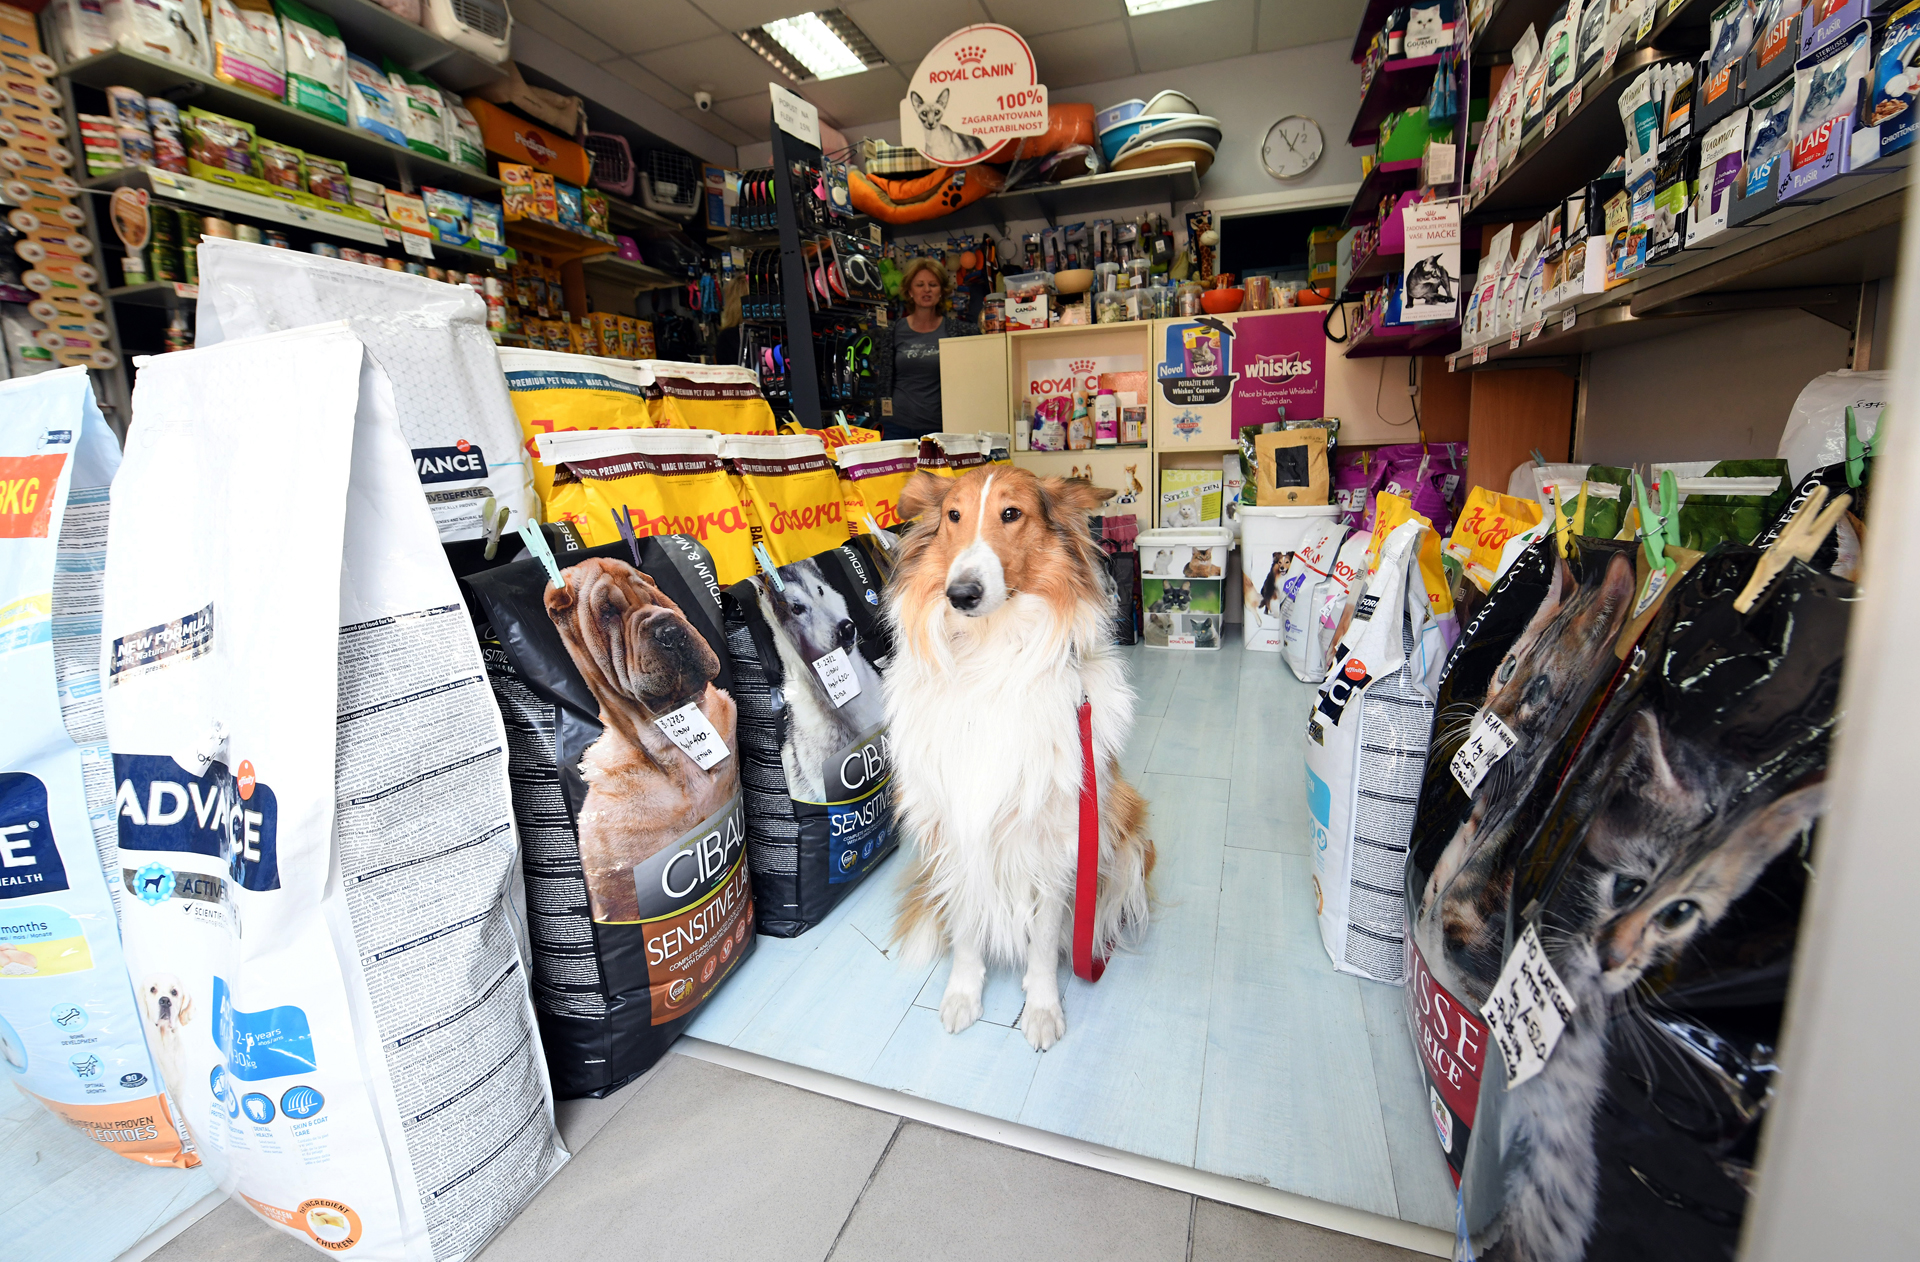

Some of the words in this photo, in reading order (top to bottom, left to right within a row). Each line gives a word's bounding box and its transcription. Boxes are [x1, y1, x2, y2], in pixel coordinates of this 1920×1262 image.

[1817, 18, 1841, 42] PLAISIR
[1407, 39, 1437, 48] GOURMET
[1815, 37, 1847, 60] STERILISED
[929, 67, 968, 84] ROYAL
[972, 63, 1014, 79] CANIN
[997, 89, 1043, 110] 100%
[801, 110, 808, 119] NA
[961, 110, 1043, 124] ZAGARANTOVANA
[972, 122, 1043, 135] PALATABILNOST
[514, 131, 558, 160] Pedigree
[1794, 170, 1817, 188] PLAISIR
[1427, 229, 1456, 239] MAČKE
[1160, 363, 1183, 376] Novo!
[1191, 364, 1218, 375] whiskas
[1245, 359, 1311, 378] whiskas
[510, 377, 546, 387] PREMIUM
[586, 379, 603, 387] MADE
[604, 379, 609, 387] IN
[1178, 379, 1201, 387] POTRAŽITE
[694, 389, 702, 397] PET
[1239, 390, 1256, 398] Mace
[1256, 389, 1262, 397] bi
[1263, 389, 1288, 397] kupovale
[1262, 397, 1278, 405] Svaki
[850, 432, 874, 444] DOG
[414, 454, 482, 475] VANCE
[599, 462, 633, 476] PREMIUM
[633, 461, 645, 470] PET
[661, 463, 678, 472] MADE
[678, 462, 684, 470] IN
[684, 461, 706, 470] GERMANY
[1163, 490, 1189, 503] Sanicat
[1202, 483, 1220, 492] ZEN
[627, 505, 748, 541] Josera
[769, 501, 842, 534] Josera
[672, 534, 693, 550] MA
[688, 550, 700, 561] &
[841, 546, 869, 584] MEDIUM
[698, 562, 723, 609] EDIUM
[1466, 598, 1496, 636] DRY
[1497, 563, 1527, 594] CAT
[366, 620, 378, 628] food
[118, 635, 153, 657] NEW
[155, 614, 210, 645] FORMULA
[117, 656, 134, 667] with
[137, 644, 168, 660] Natural
[351, 708, 374, 719] completo
[407, 695, 418, 703] para
[418, 690, 432, 700] perros
[433, 685, 449, 695] adultos
[840, 735, 891, 790] CIBA
[238, 775, 256, 788] affinity
[355, 794, 378, 804] Aliment
[378, 786, 399, 800] complet
[662, 796, 746, 898] CIBAU
[360, 869, 386, 881] Alimento
[1, 922, 48, 934] months
[647, 887, 734, 966] SENSITIVE
[378, 946, 404, 960] Alimento
[404, 936, 429, 950] completo
[669, 949, 698, 972] COMPLETE
[699, 942, 709, 953] AND
[682, 958, 695, 971] WITH
[1404, 932, 1480, 1072] TISSE
[61, 1038, 98, 1046] DEVELOPMENT
[255, 1027, 282, 1041] years
[1423, 1023, 1462, 1091] RICE
[115, 1116, 154, 1129] PROVEN
[293, 1122, 307, 1130] SKIN
[314, 1116, 328, 1125] COAT
[295, 1129, 310, 1137] CARE
[259, 1202, 294, 1220] CHICKEN
[304, 1199, 350, 1215] INGREDIENT
[316, 1236, 354, 1249] CHICKEN
